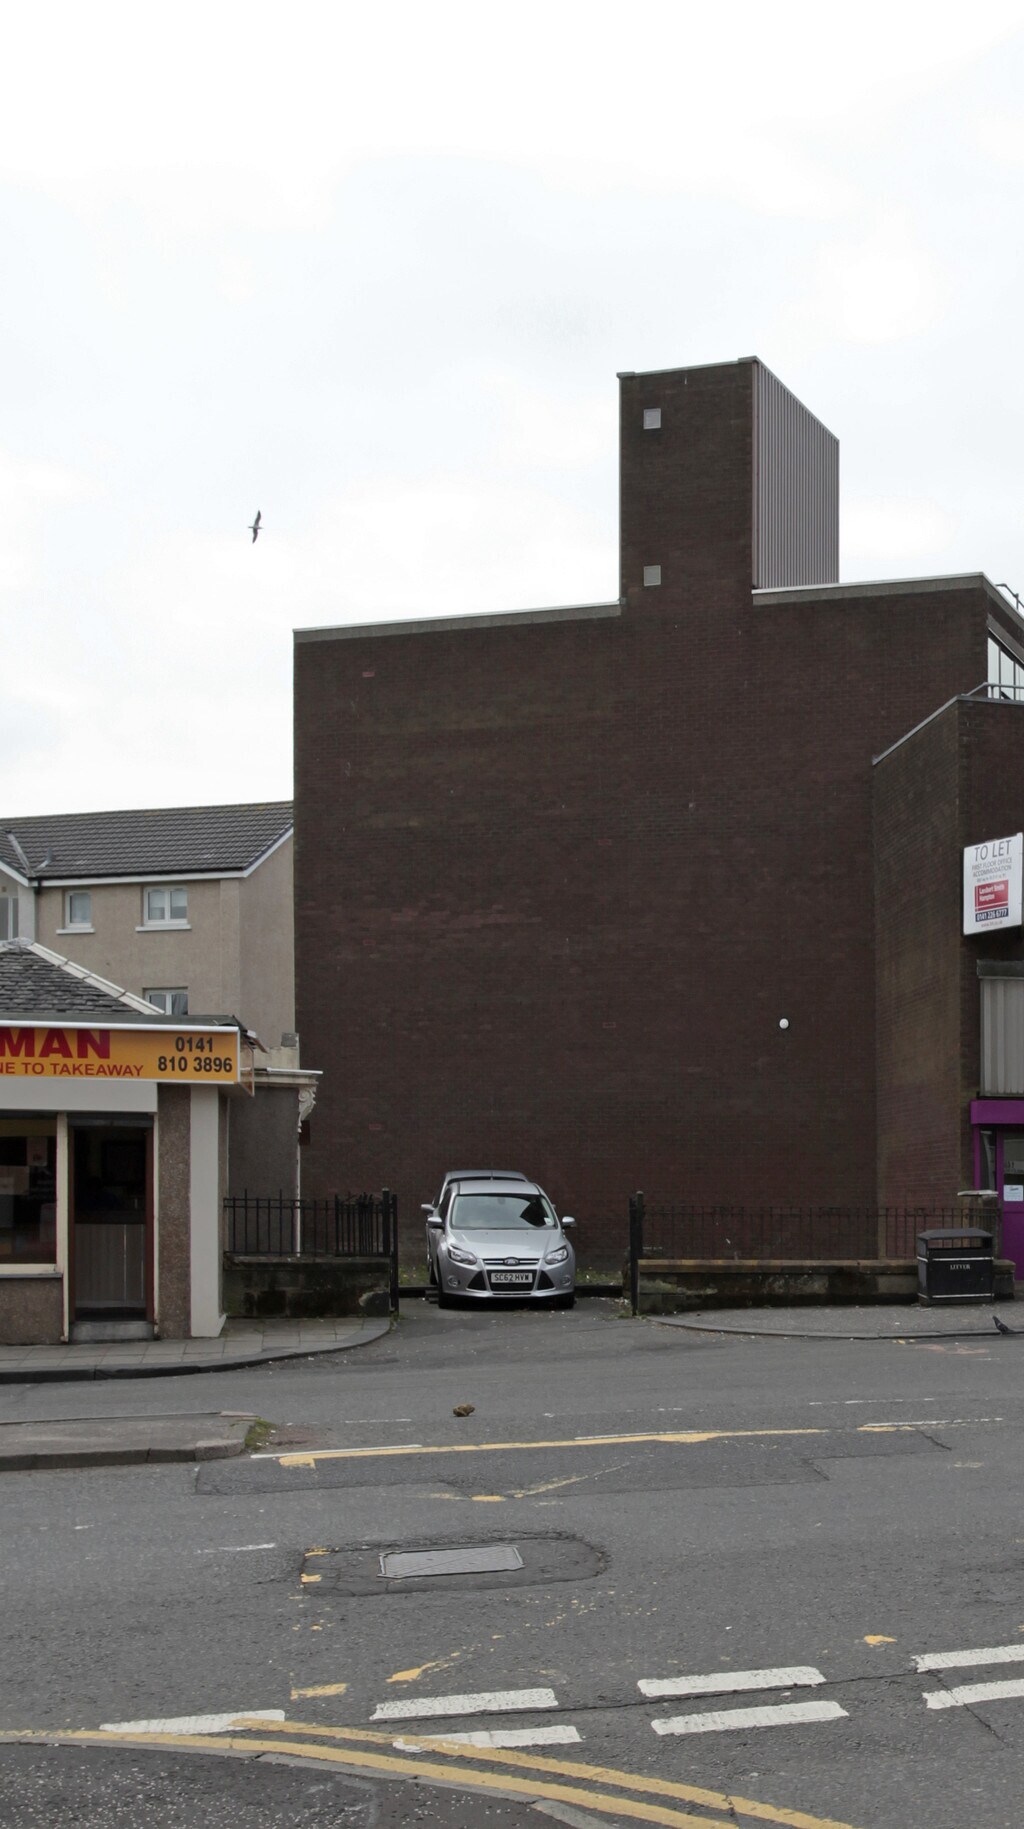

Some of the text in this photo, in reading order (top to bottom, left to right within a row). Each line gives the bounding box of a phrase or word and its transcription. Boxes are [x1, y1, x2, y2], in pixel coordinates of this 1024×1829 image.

[974, 840, 1011, 861] TO LET
[0, 1027, 110, 1059] MAN
[175, 1036, 213, 1053] 0141
[21, 1062, 45, 1075] TO
[50, 1063, 144, 1077] TAKEAWAY
[158, 1055, 233, 1073] 810 3896
